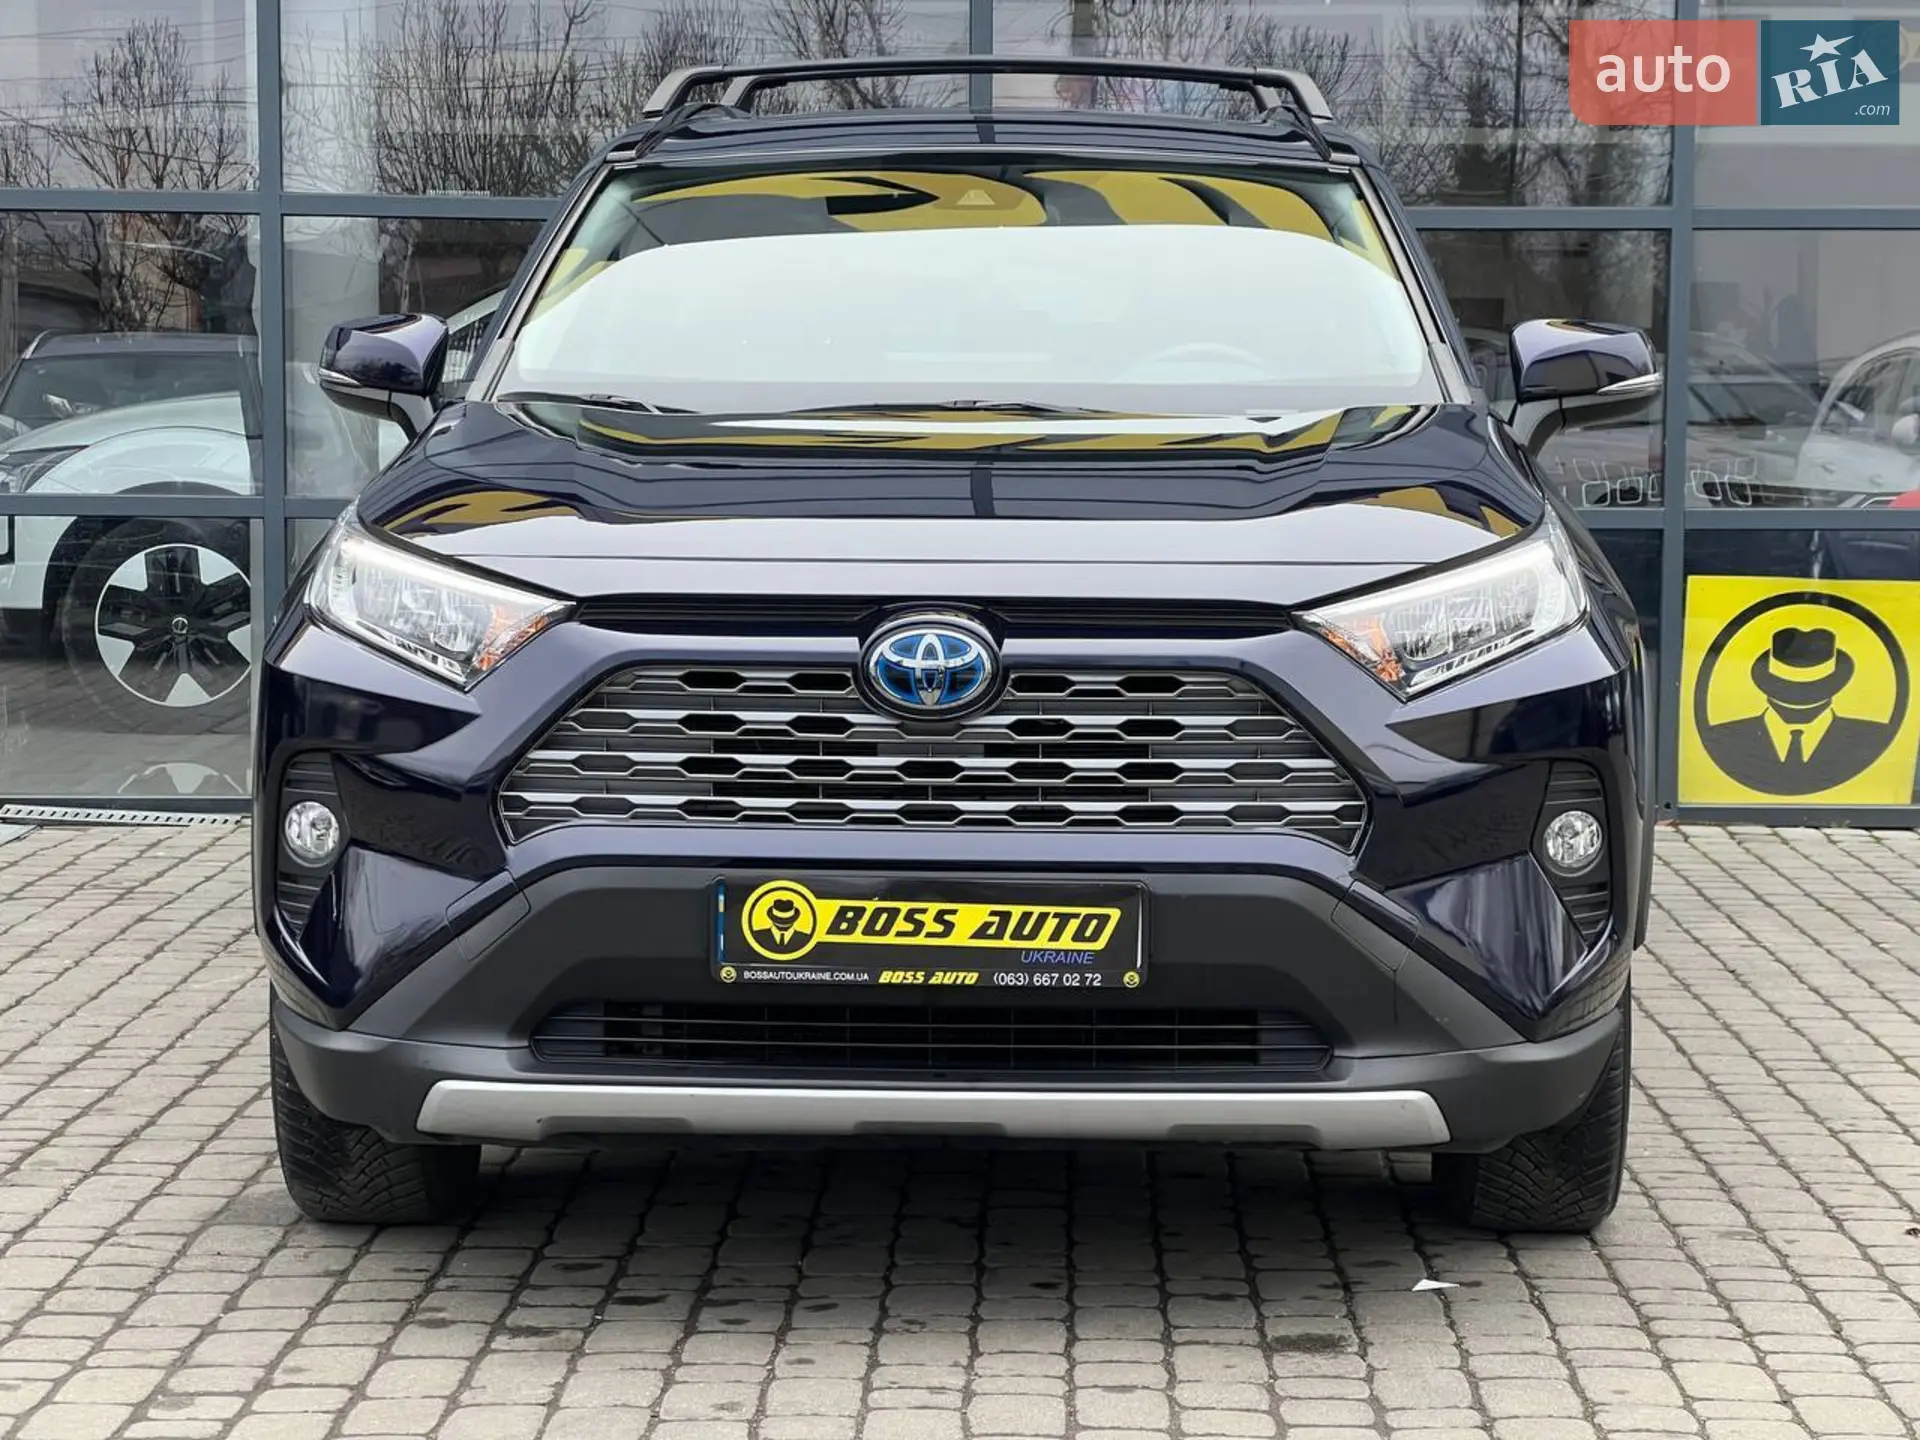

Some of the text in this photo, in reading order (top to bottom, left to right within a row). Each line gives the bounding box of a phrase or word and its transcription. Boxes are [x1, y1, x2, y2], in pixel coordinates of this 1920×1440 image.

[826, 906, 1111, 943] BOSS AUTO
[1021, 950, 1095, 964] UKRAINE
[743, 971, 869, 981] BOSSAUTOUKRAINE.COM.UA
[878, 970, 980, 985] BOSS AUTO
[993, 973, 1102, 986] (063) 667 02 72
